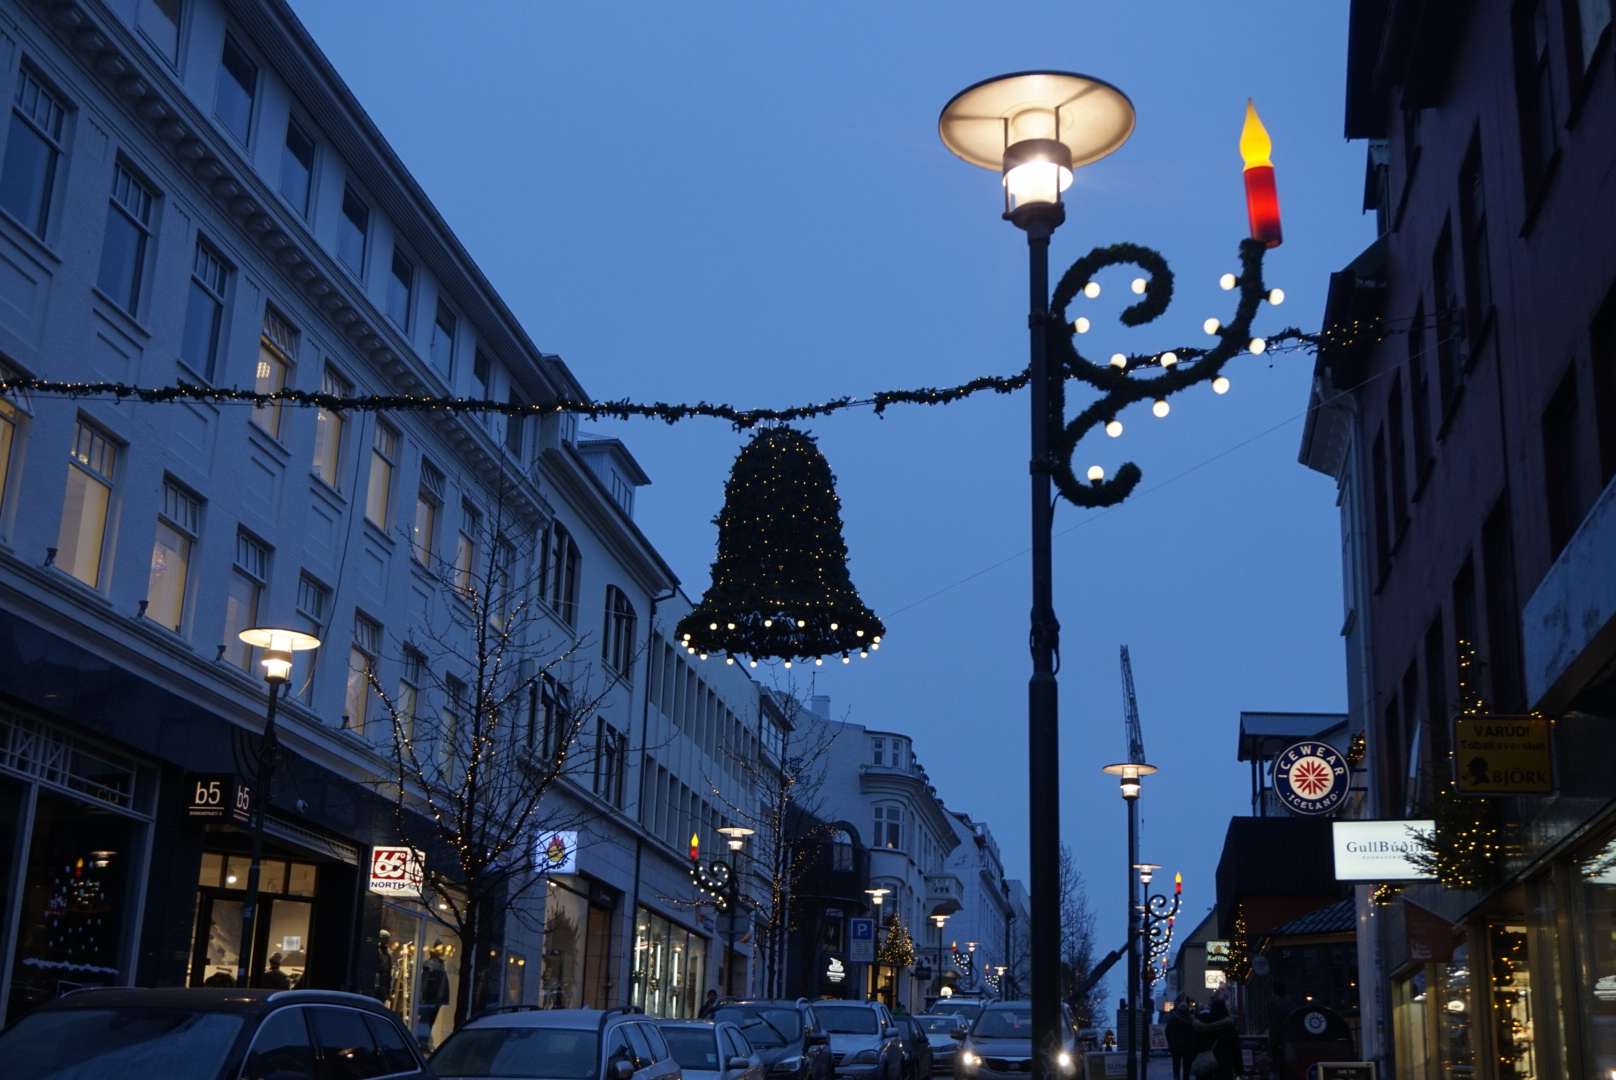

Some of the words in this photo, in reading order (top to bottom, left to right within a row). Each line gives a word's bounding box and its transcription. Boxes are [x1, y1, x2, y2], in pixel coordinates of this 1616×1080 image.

[1278, 745, 1345, 778] ICEWEAR
[1493, 767, 1548, 785] BJÖRK
[195, 781, 221, 804] b5
[237, 785, 250, 810] b5
